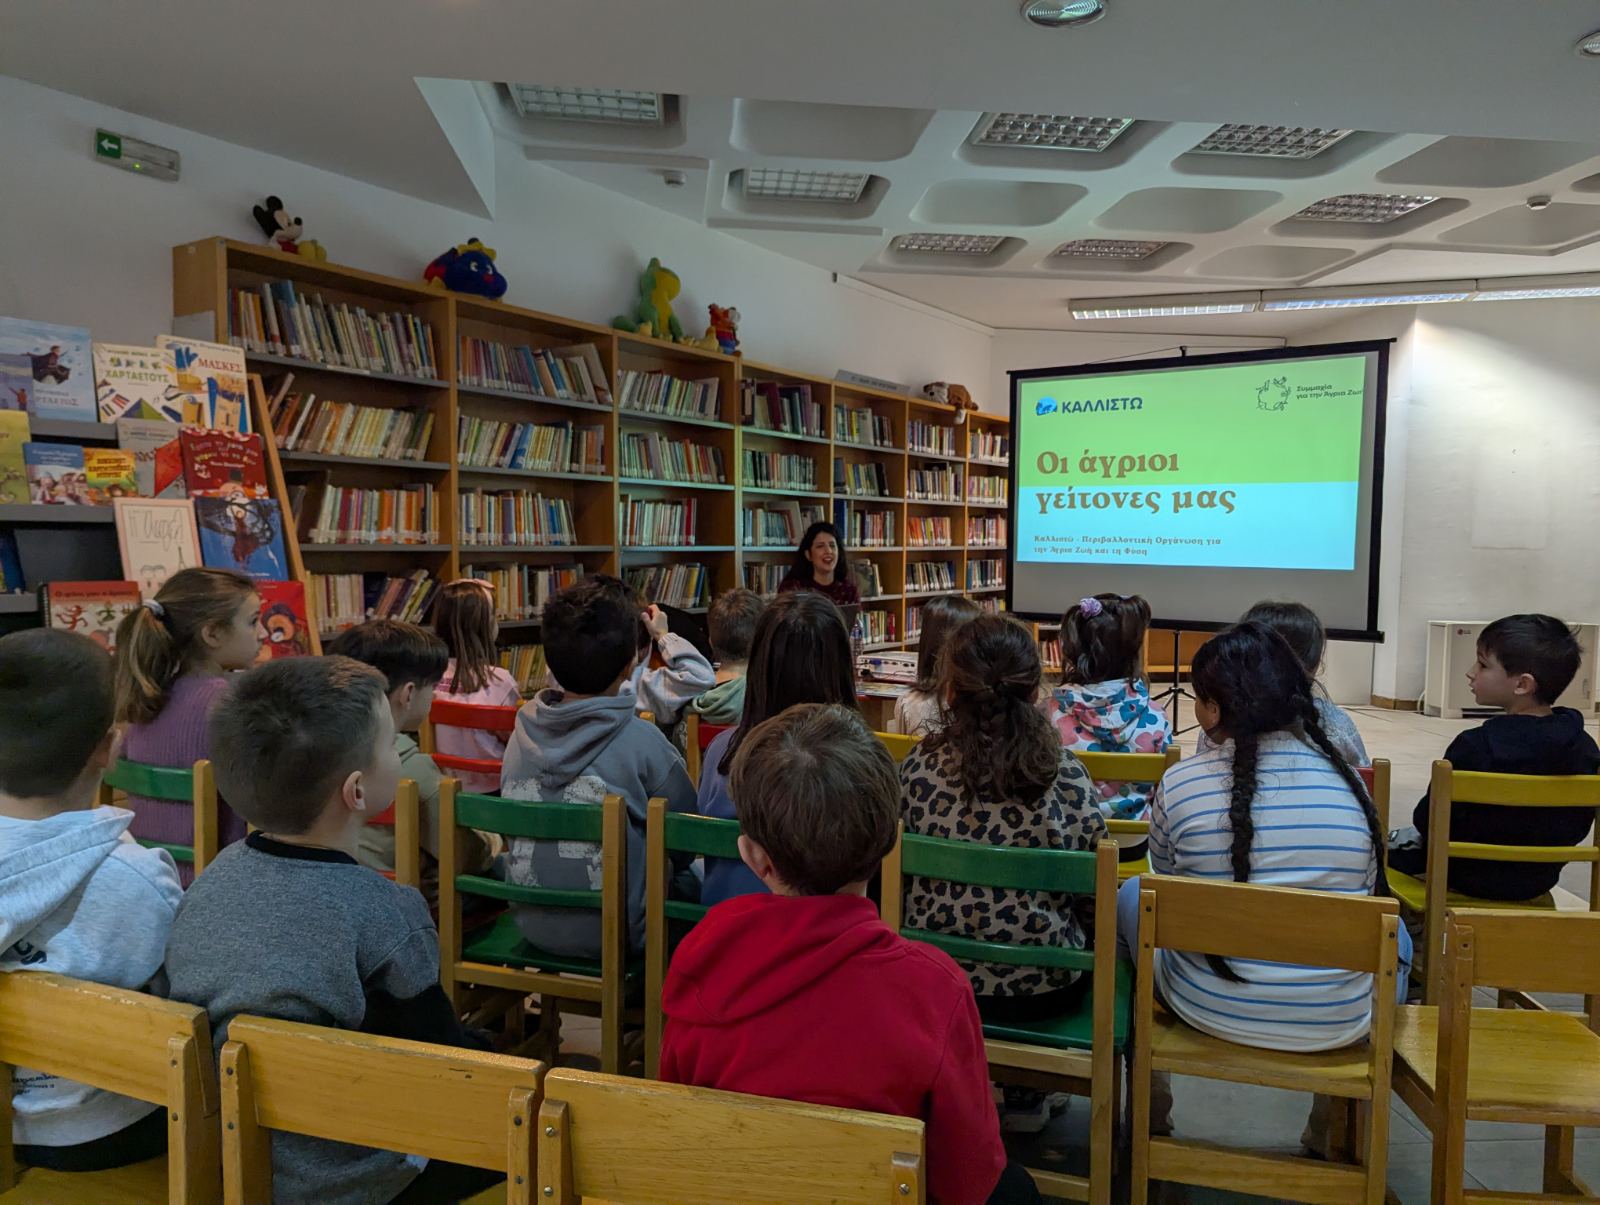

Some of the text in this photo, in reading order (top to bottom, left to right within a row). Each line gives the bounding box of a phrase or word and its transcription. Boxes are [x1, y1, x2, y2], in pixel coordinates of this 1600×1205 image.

[198, 358, 243, 373] ΜΑΣΚΕΣ
[105, 370, 169, 383] ΧΑΡΤΑΕΤΟΥΣ
[1296, 383, 1332, 392] Συμμαχία
[1061, 397, 1143, 414] ΚΑΛΛΙΣΤΩ
[1036, 449, 1179, 478] Οι άγριοι
[1036, 486, 1236, 514] γείτονες μας
[1082, 535, 1152, 545] Περιβαλλοντική
[1155, 536, 1203, 545] Οργάνωση
[1206, 537, 1221, 545] για
[1034, 546, 1047, 554] την
[1075, 546, 1092, 555] Ζωή
[1095, 547, 1109, 555] και
[1124, 546, 1147, 556] Φύση
